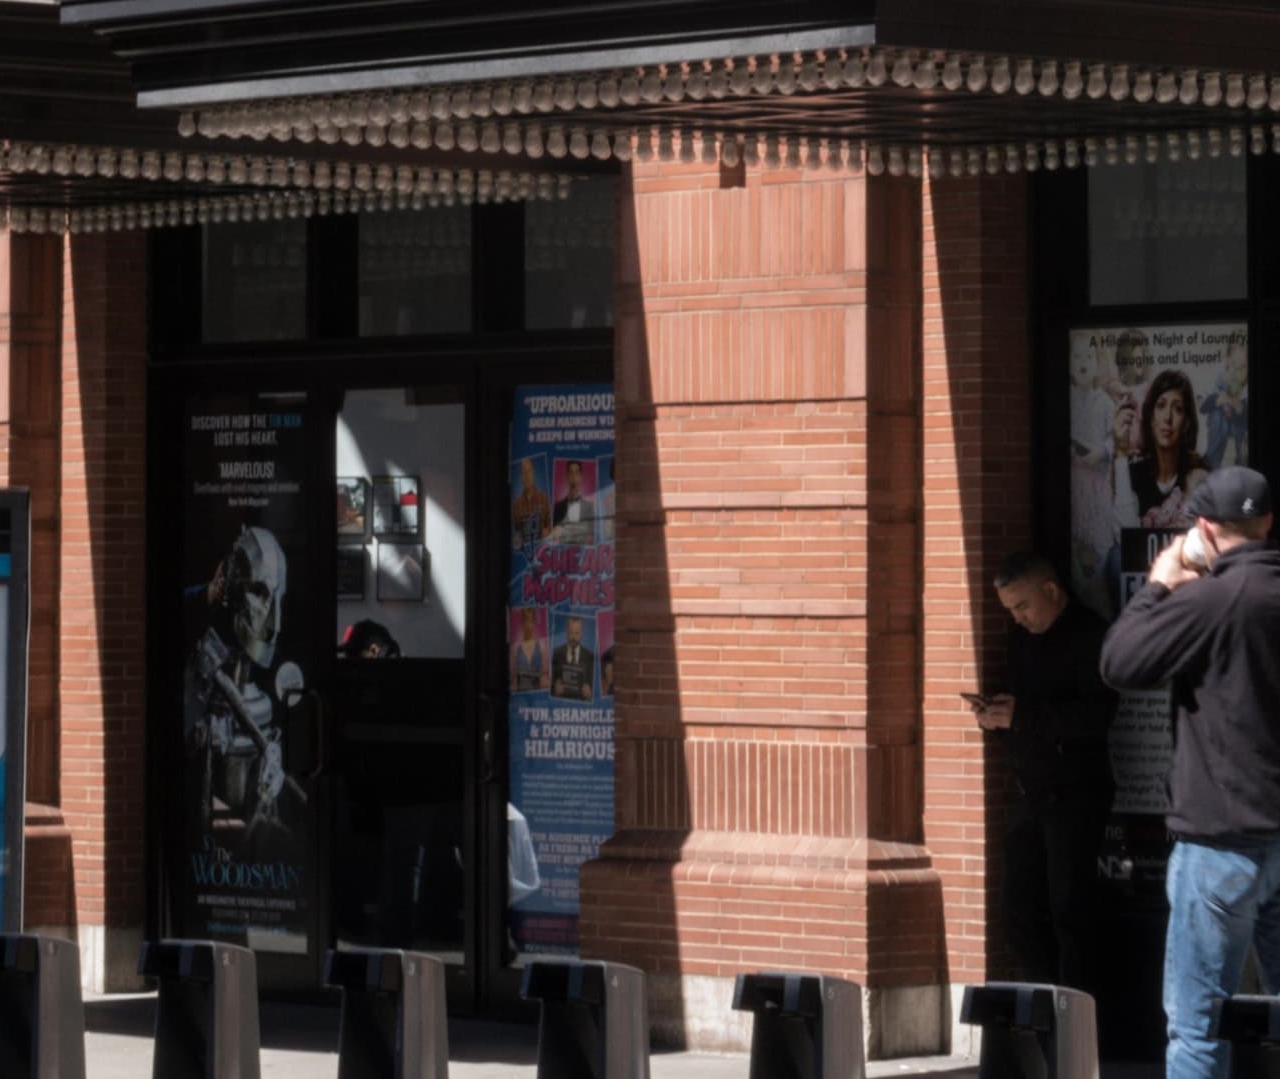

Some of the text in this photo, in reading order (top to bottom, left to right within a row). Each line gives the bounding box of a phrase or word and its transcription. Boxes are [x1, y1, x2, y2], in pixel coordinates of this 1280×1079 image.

[1089, 335, 1097, 348] A
[1153, 332, 1183, 349] Night
[1187, 331, 1198, 345] of
[1157, 352, 1179, 365] and
[1183, 351, 1222, 367] Liquor!
[523, 574, 615, 606] MADNES
[552, 707, 615, 723] SHAMELE
